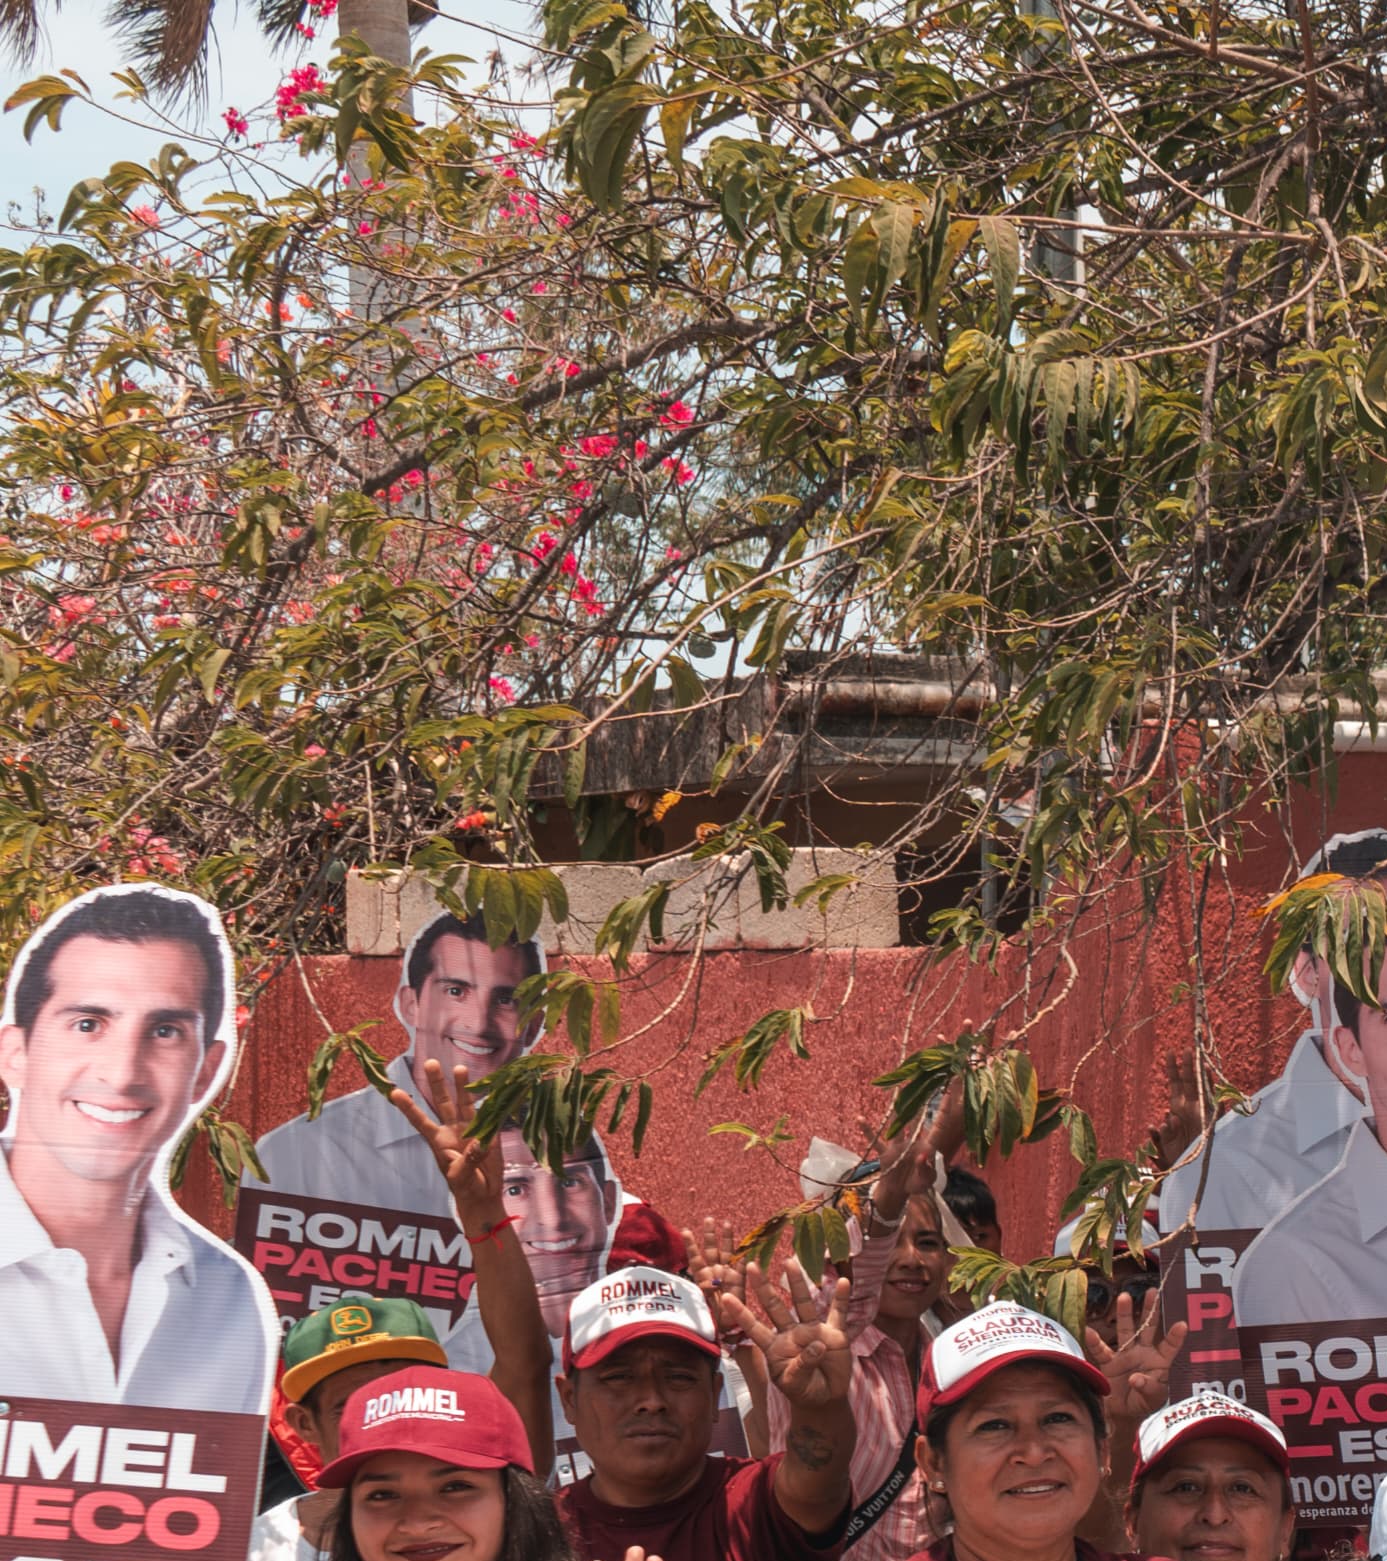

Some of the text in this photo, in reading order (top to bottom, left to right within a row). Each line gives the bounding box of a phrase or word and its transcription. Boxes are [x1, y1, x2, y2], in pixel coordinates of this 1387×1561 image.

[601, 1280, 681, 1305] ROMMEL
[609, 1302, 675, 1315] morena
[972, 1307, 1026, 1321] morena
[954, 1316, 1058, 1344] CLAUDIA
[957, 1327, 1062, 1350] SHEINBAUM
[364, 1387, 465, 1423] ROMMEL
[1163, 1402, 1254, 1423] HUACHO
[0, 1419, 228, 1493] MEL
[861, 1470, 905, 1518] VUITTON
[1300, 1506, 1358, 1523] esperanza
